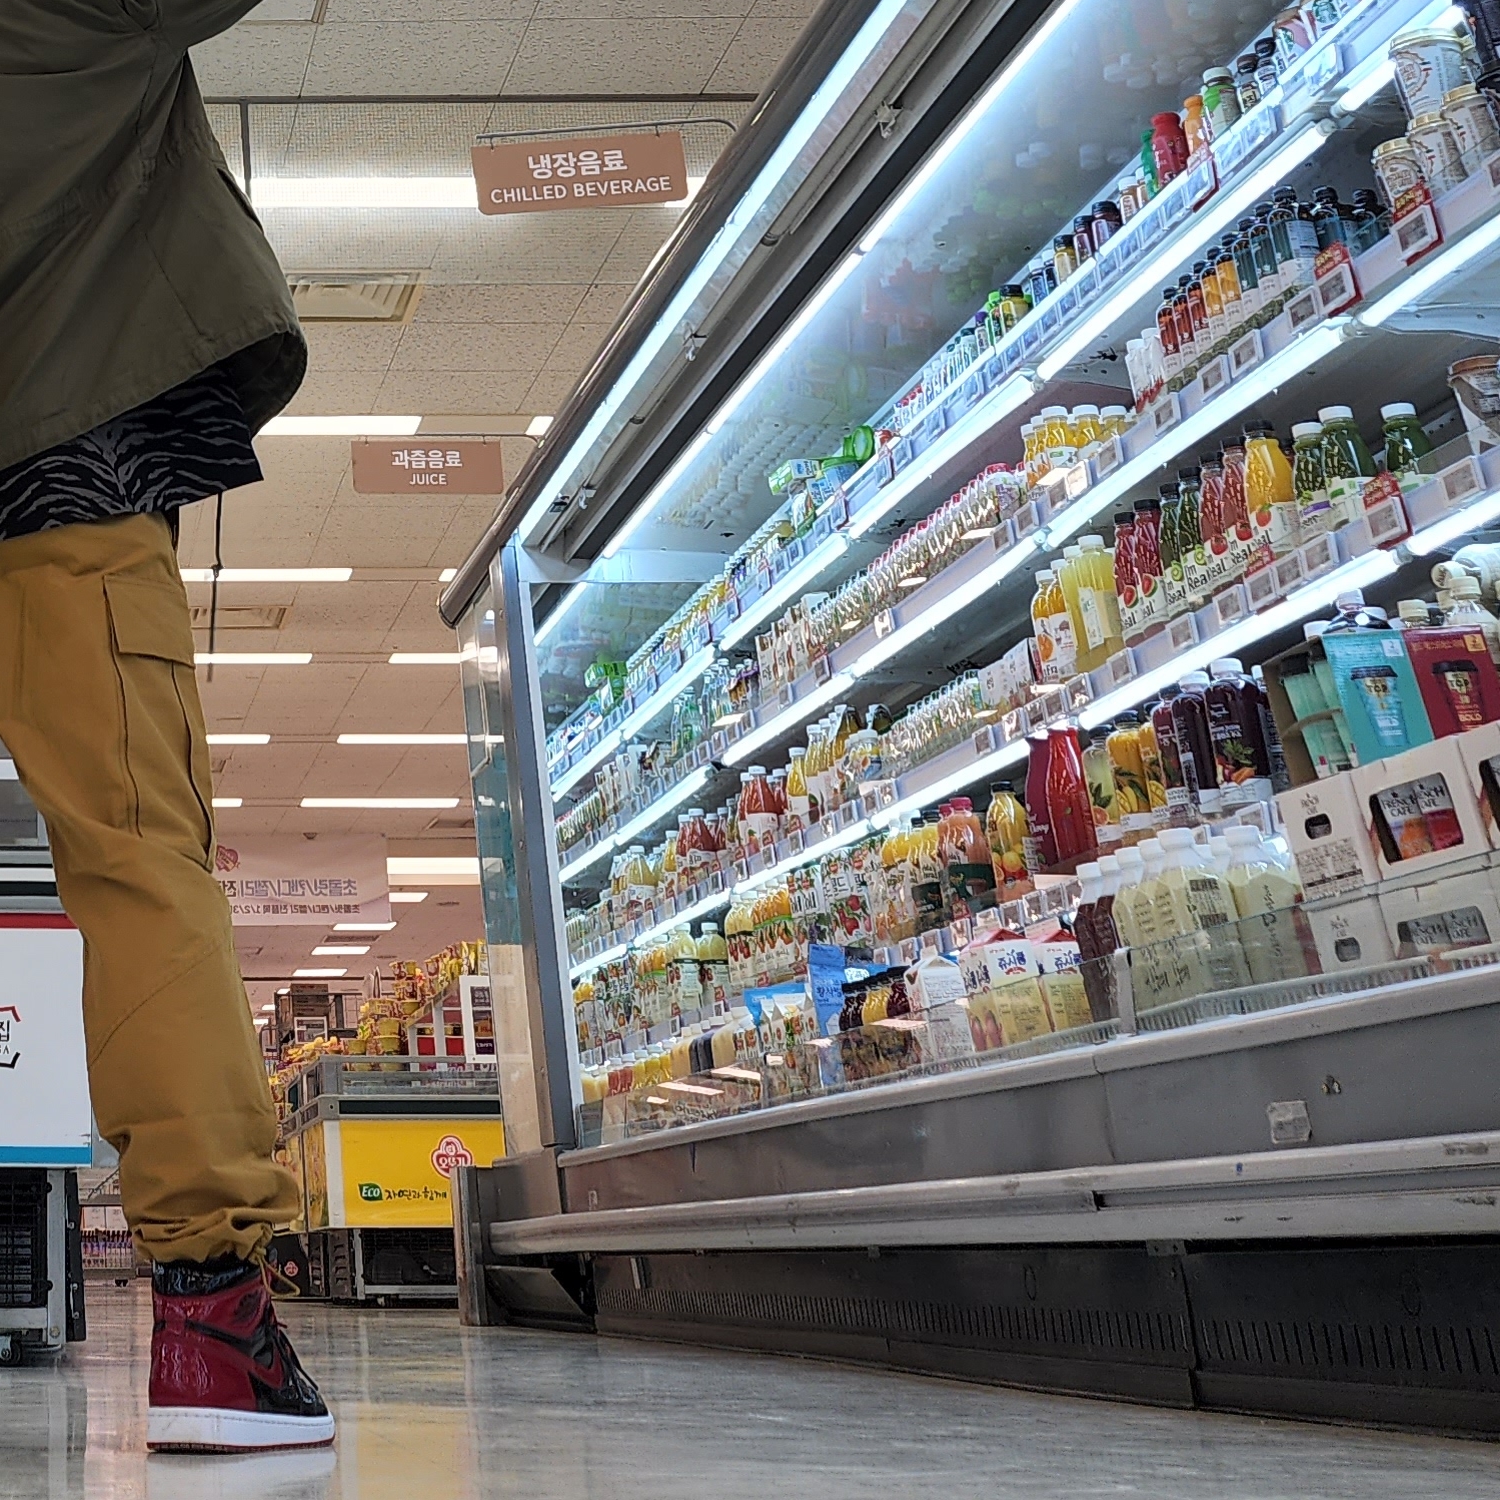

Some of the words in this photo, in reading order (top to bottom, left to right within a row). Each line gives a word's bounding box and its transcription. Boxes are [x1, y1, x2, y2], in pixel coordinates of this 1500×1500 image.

[527, 149, 628, 180] 냉장음료
[490, 183, 568, 204] CHILLED
[573, 175, 672, 198] BEVERAGE
[391, 449, 463, 470] 과즙음료
[409, 472, 448, 486] JUICE
